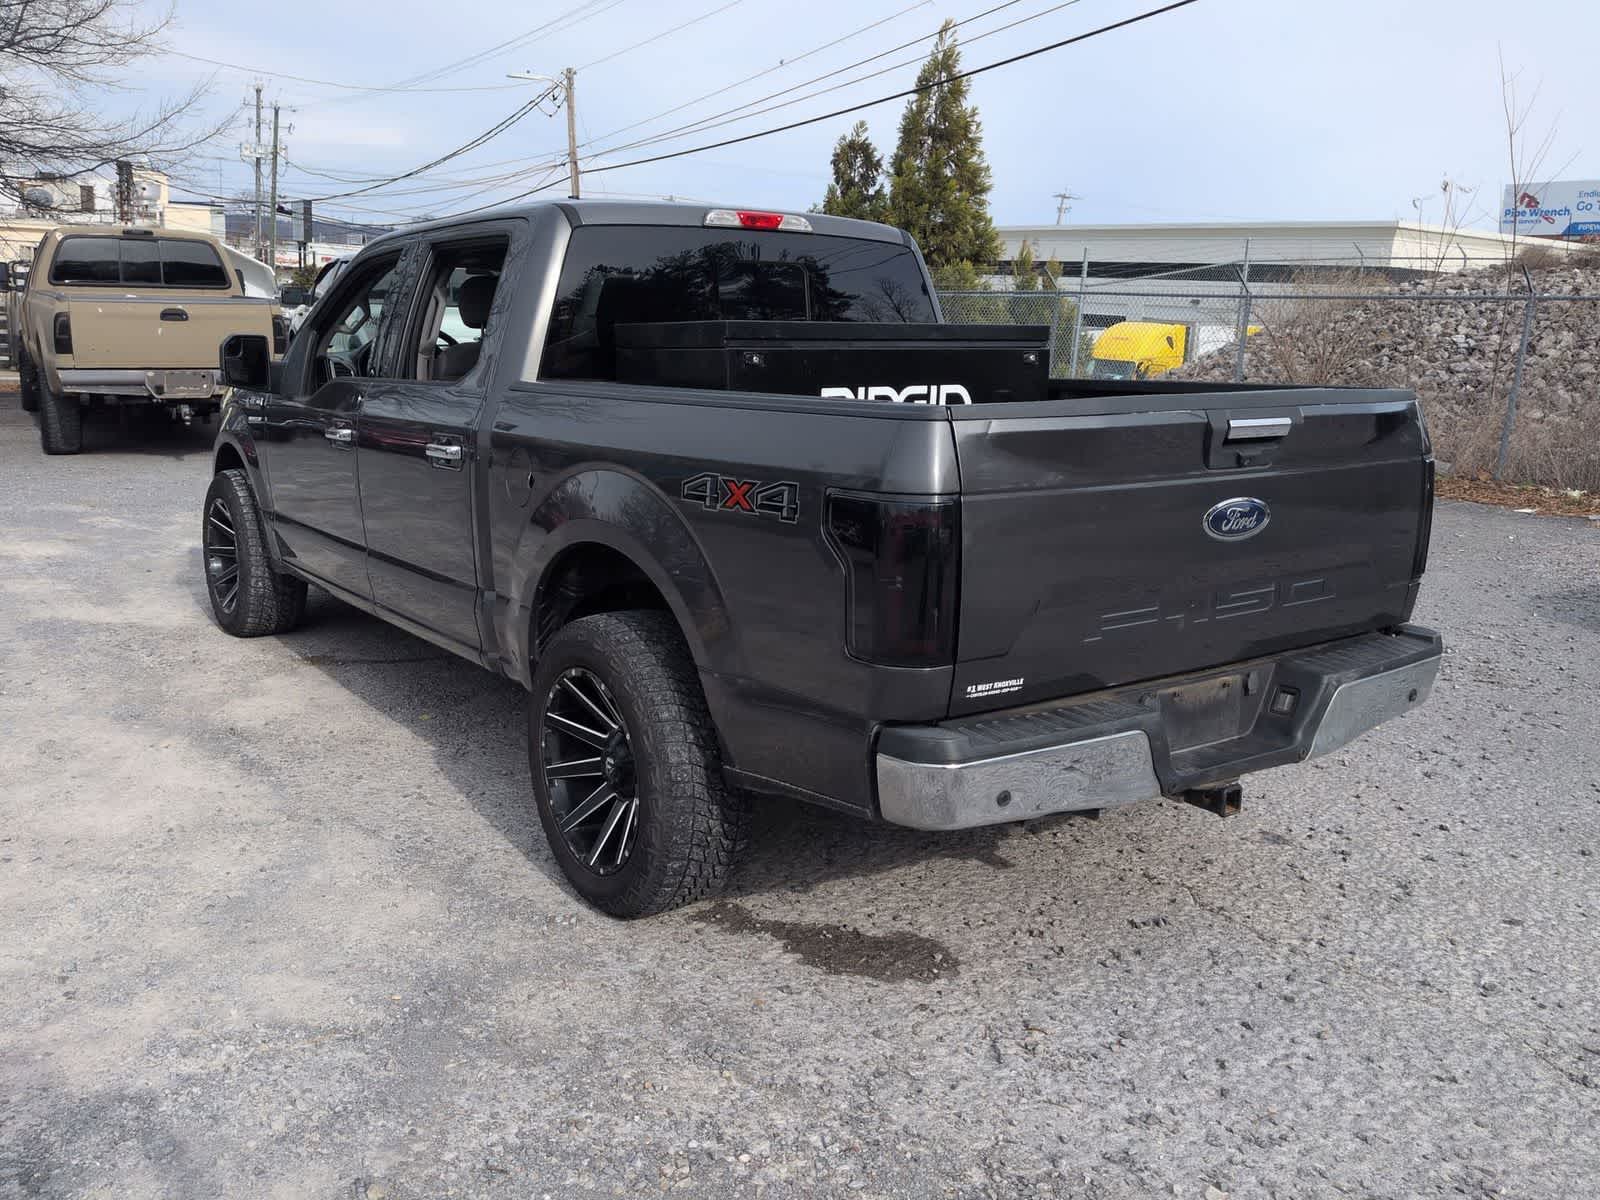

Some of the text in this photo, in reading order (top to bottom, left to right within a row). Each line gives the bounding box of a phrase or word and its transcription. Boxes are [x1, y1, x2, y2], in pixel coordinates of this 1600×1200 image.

[1504, 205, 1570, 218] Pipe Wrench
[1576, 200, 1593, 211] Go
[821, 384, 972, 405] GID
[1222, 507, 1258, 531] Ford
[976, 683, 994, 692] WEST
[993, 678, 1024, 689] KNOXVILLE
